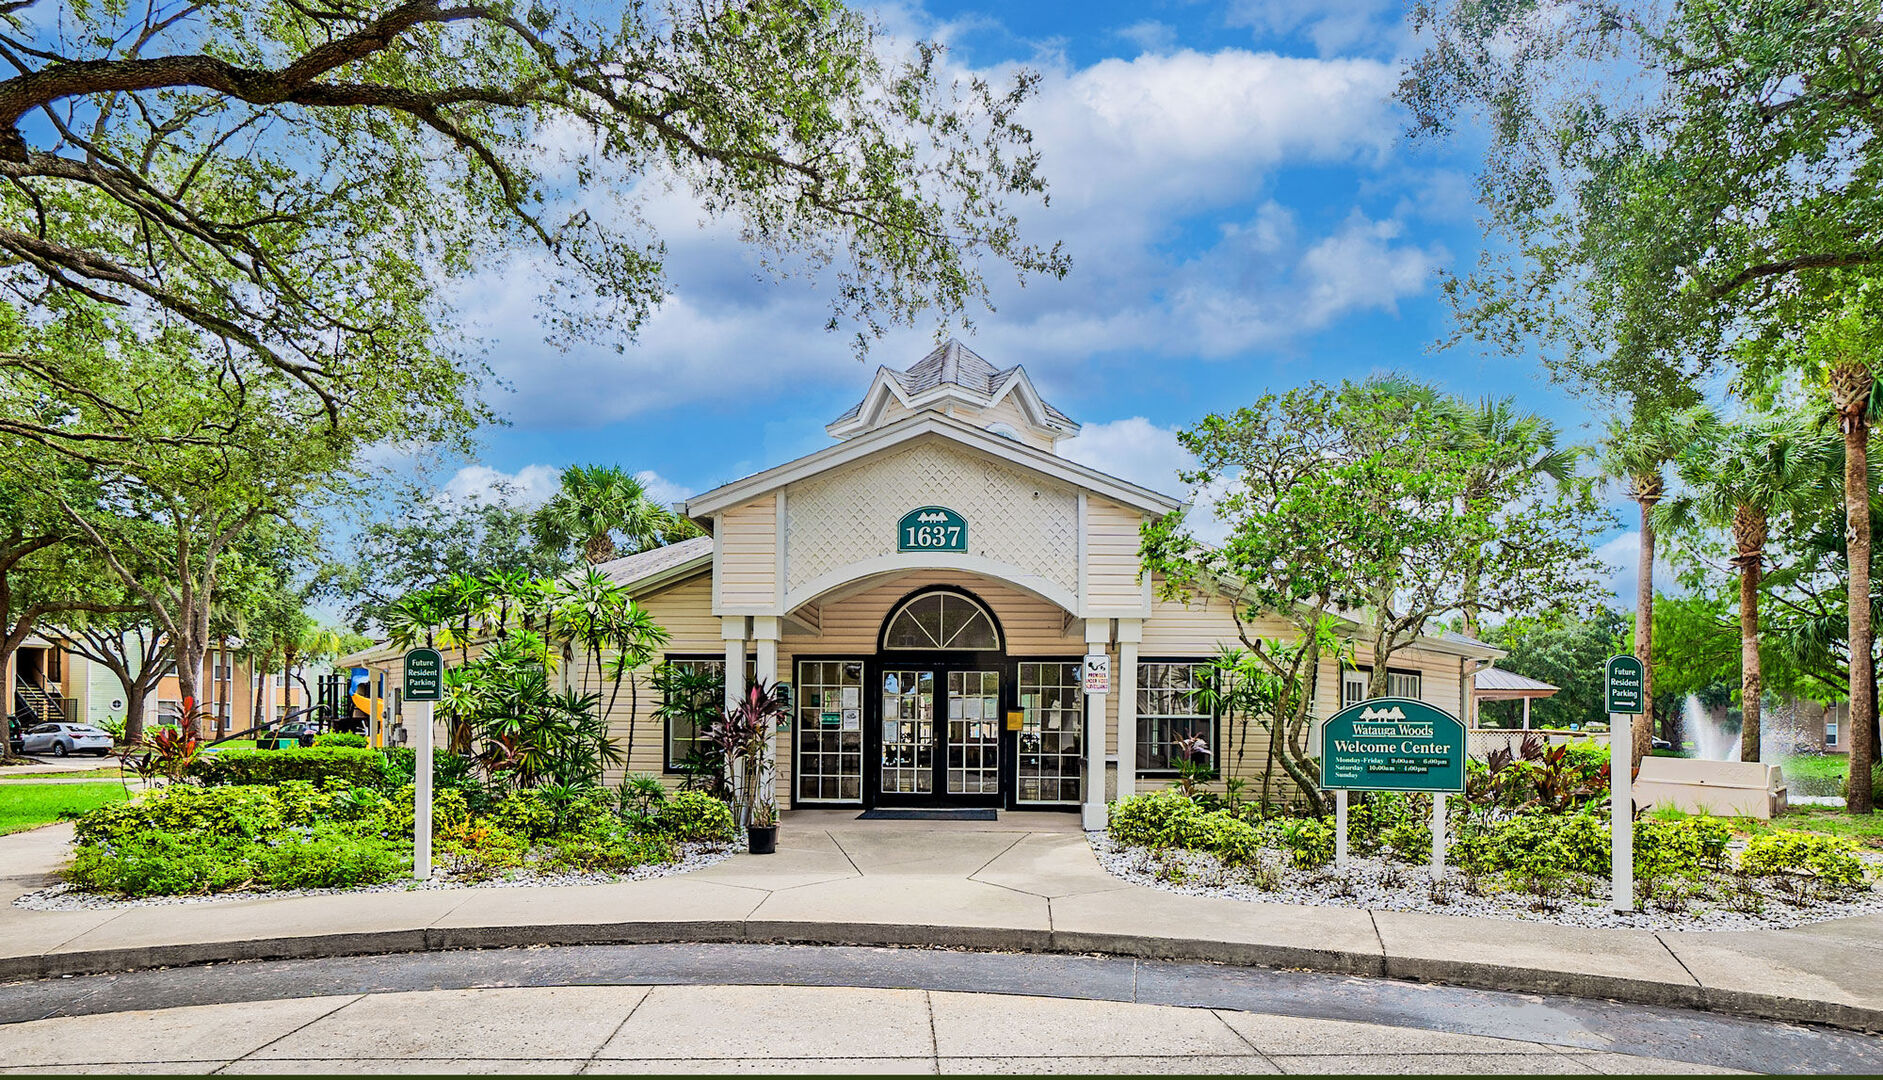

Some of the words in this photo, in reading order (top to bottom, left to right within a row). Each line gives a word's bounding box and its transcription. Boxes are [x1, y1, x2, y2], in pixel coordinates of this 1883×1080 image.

[906, 526, 960, 547] 1637
[408, 669, 438, 677] Resident
[1614, 667, 1636, 676] Future
[409, 679, 436, 687] Parking
[1610, 678, 1640, 687] Resident
[1612, 688, 1638, 699] Parking
[1352, 724, 1396, 736] Watauga
[1398, 724, 1434, 736] Woods
[1334, 740, 1397, 754] Welcome
[1400, 740, 1451, 755] Center
[1335, 756, 1384, 764] Monday-Friday
[1335, 764, 1364, 772] Saturday
[1335, 771, 1359, 779] Sunday
